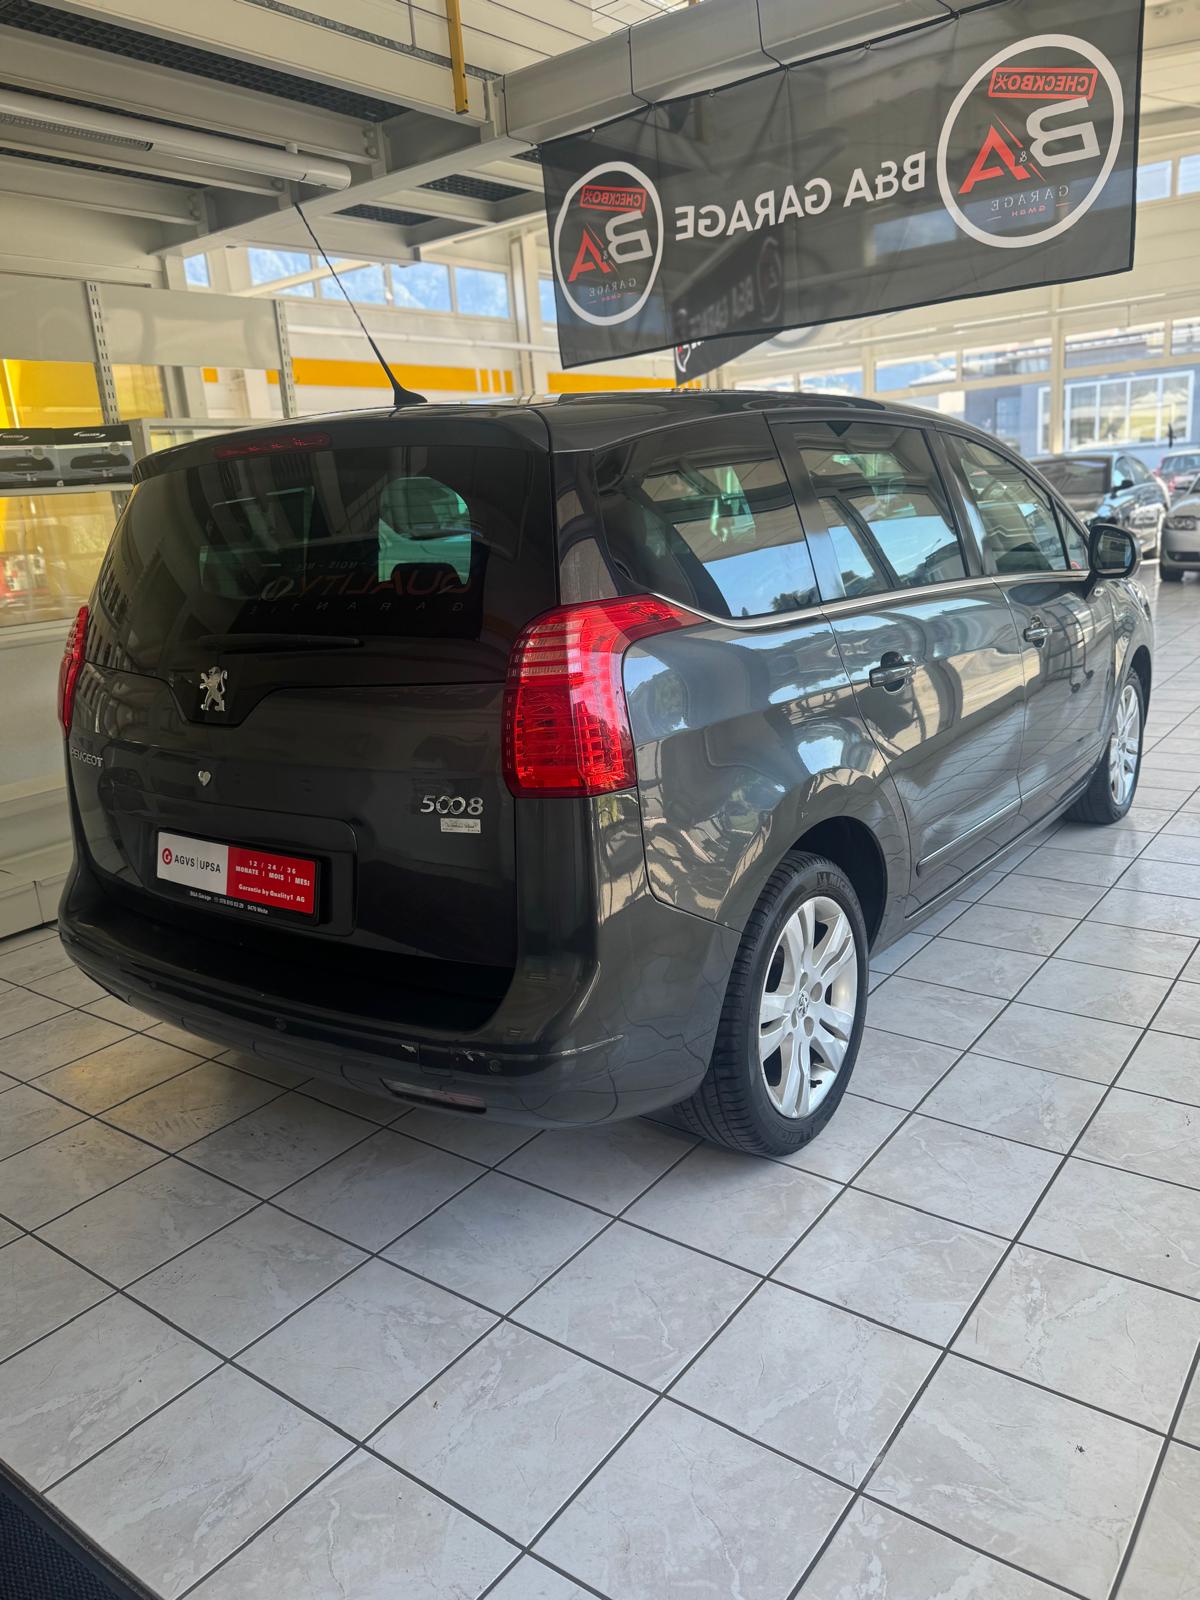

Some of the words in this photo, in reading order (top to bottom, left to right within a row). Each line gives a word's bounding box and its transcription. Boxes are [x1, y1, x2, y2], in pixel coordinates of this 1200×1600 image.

[71, 747, 103, 767] PEUGEOT
[420, 794, 484, 816] 5008
[174, 854, 195, 868] AGVS
[200, 861, 221, 874] UPSA
[268, 872, 285, 881] MOIS
[294, 877, 311, 887] MESI
[238, 883, 262, 894] Garantie
[262, 888, 269, 897] by
[296, 895, 305, 903] AG
